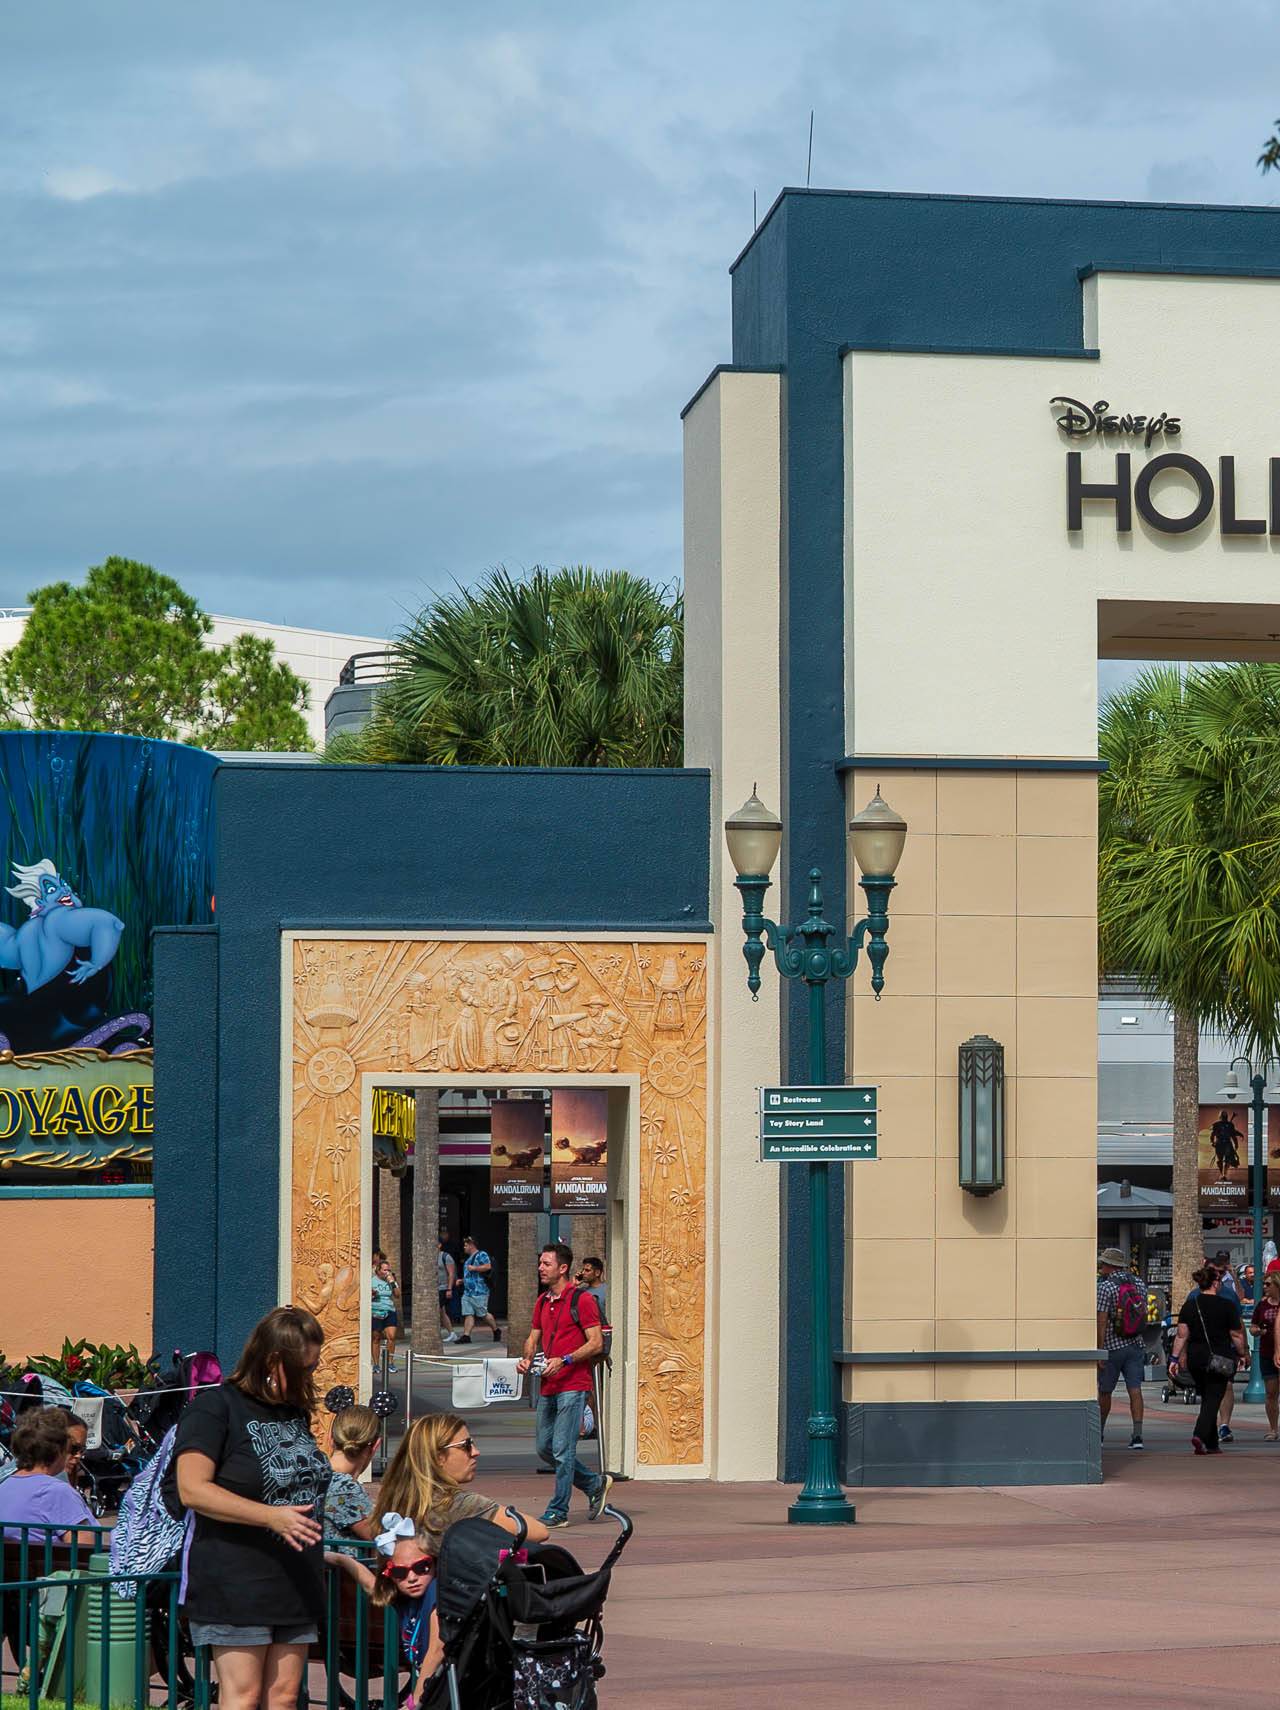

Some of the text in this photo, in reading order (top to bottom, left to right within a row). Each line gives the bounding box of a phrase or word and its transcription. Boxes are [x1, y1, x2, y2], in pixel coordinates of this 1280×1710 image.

[783, 1096, 821, 1104] Restrooms
[769, 1120, 782, 1128] Toy
[785, 1119, 804, 1128] Story
[770, 1144, 862, 1153] An Incredible Celebration
[493, 1185, 541, 1195] MANDALORIAN
[1200, 1186, 1246, 1196] MANDALORIAN
[1229, 1226, 1268, 1235] CARO
